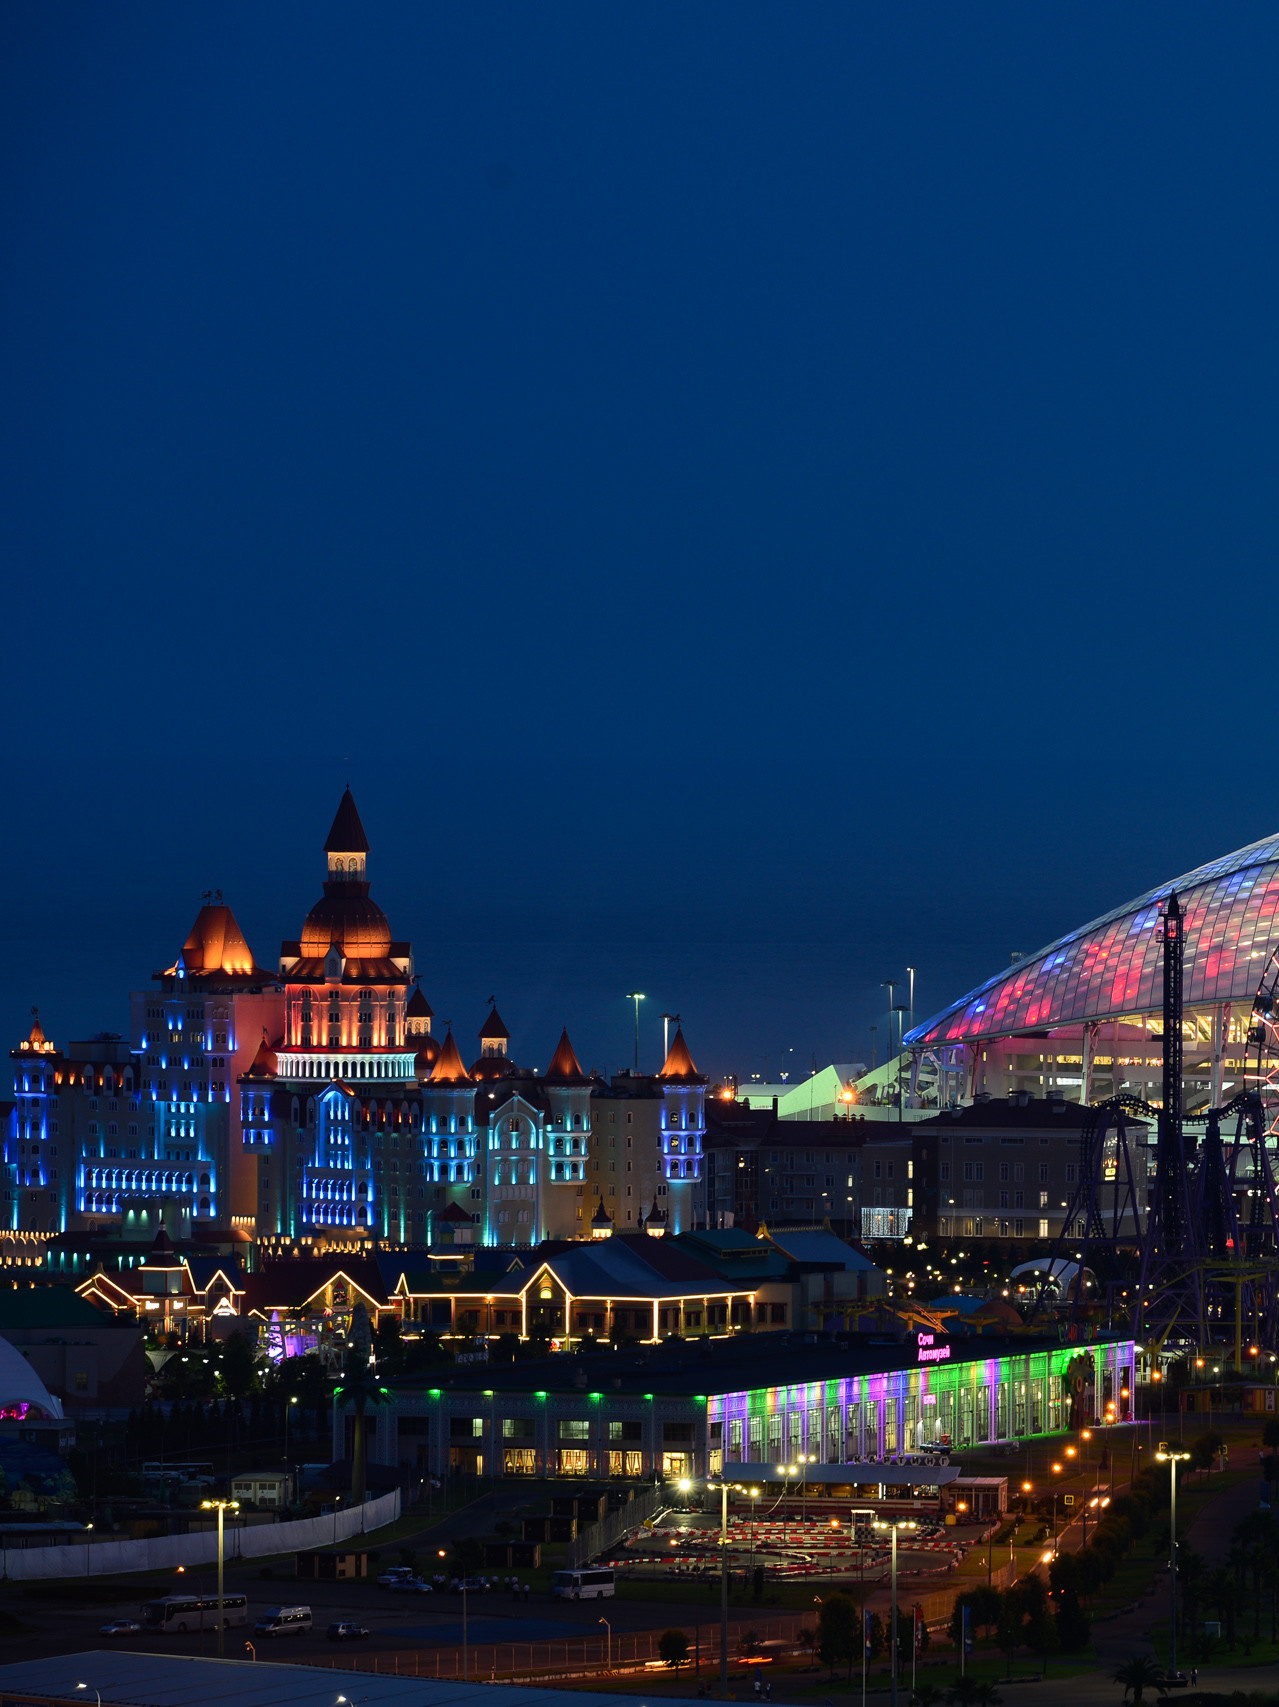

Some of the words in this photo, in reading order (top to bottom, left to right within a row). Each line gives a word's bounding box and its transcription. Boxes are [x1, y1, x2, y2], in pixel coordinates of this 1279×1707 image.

[917, 1332, 934, 1346] Сочи
[917, 1344, 951, 1362] Автомузей
[853, 1454, 949, 1466] КАРТИНГ
